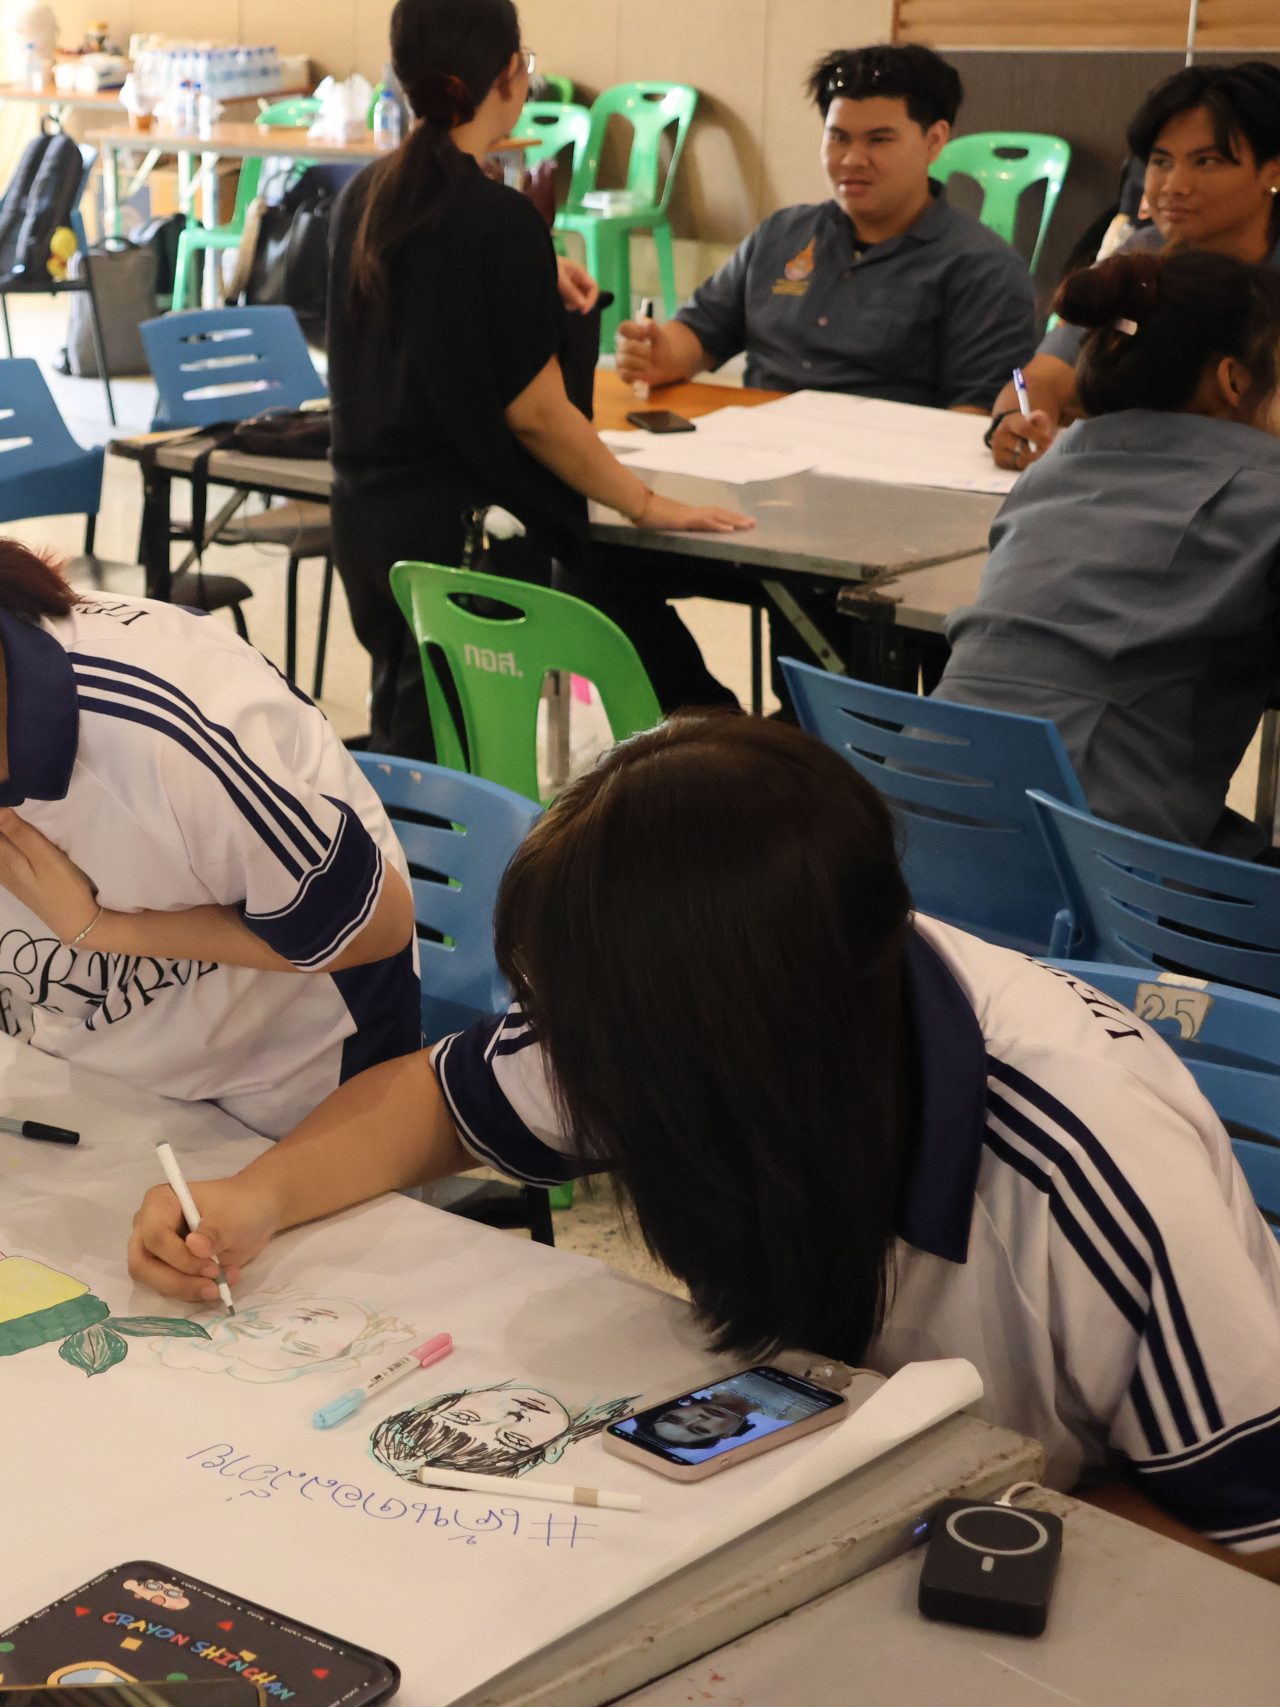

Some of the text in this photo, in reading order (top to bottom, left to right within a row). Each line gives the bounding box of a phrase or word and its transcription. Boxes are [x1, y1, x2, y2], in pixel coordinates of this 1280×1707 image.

[1141, 993, 1195, 1041] 25
[102, 1612, 190, 1647] CRAYON
[190, 1641, 295, 1700] SHINCHAN
